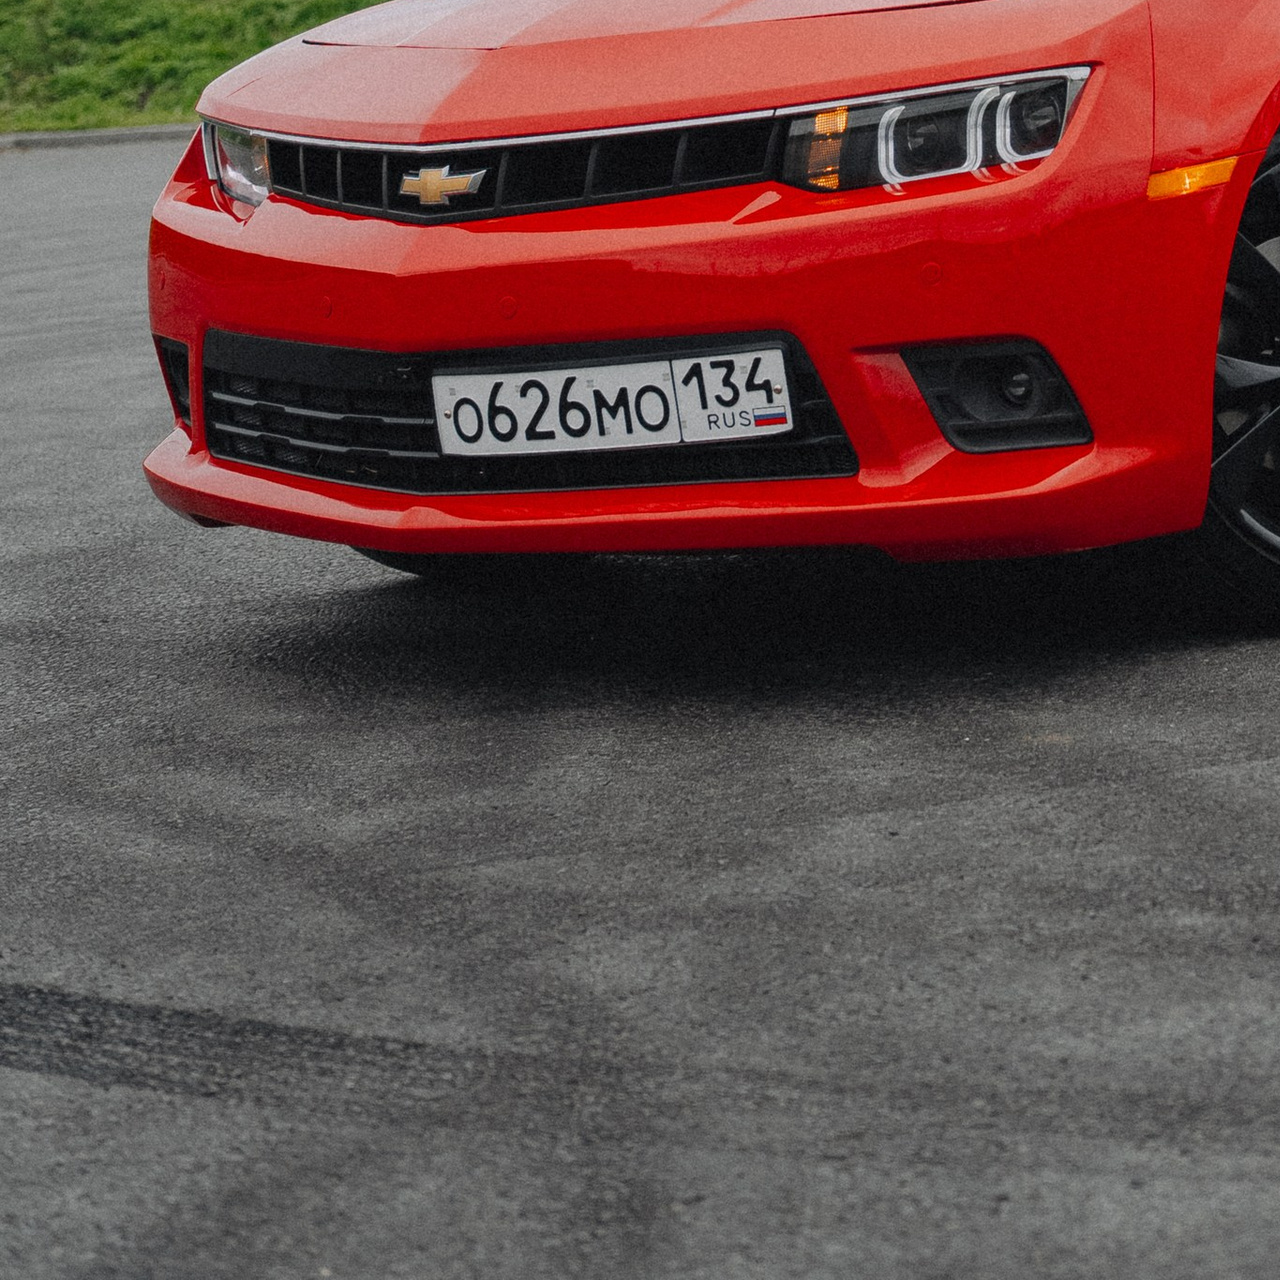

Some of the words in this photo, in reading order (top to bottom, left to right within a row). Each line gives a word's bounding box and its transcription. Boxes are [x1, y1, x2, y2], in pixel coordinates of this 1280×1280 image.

[453, 376, 670, 443] O626MO
[681, 356, 774, 410] 134
[708, 409, 752, 430] RUS
